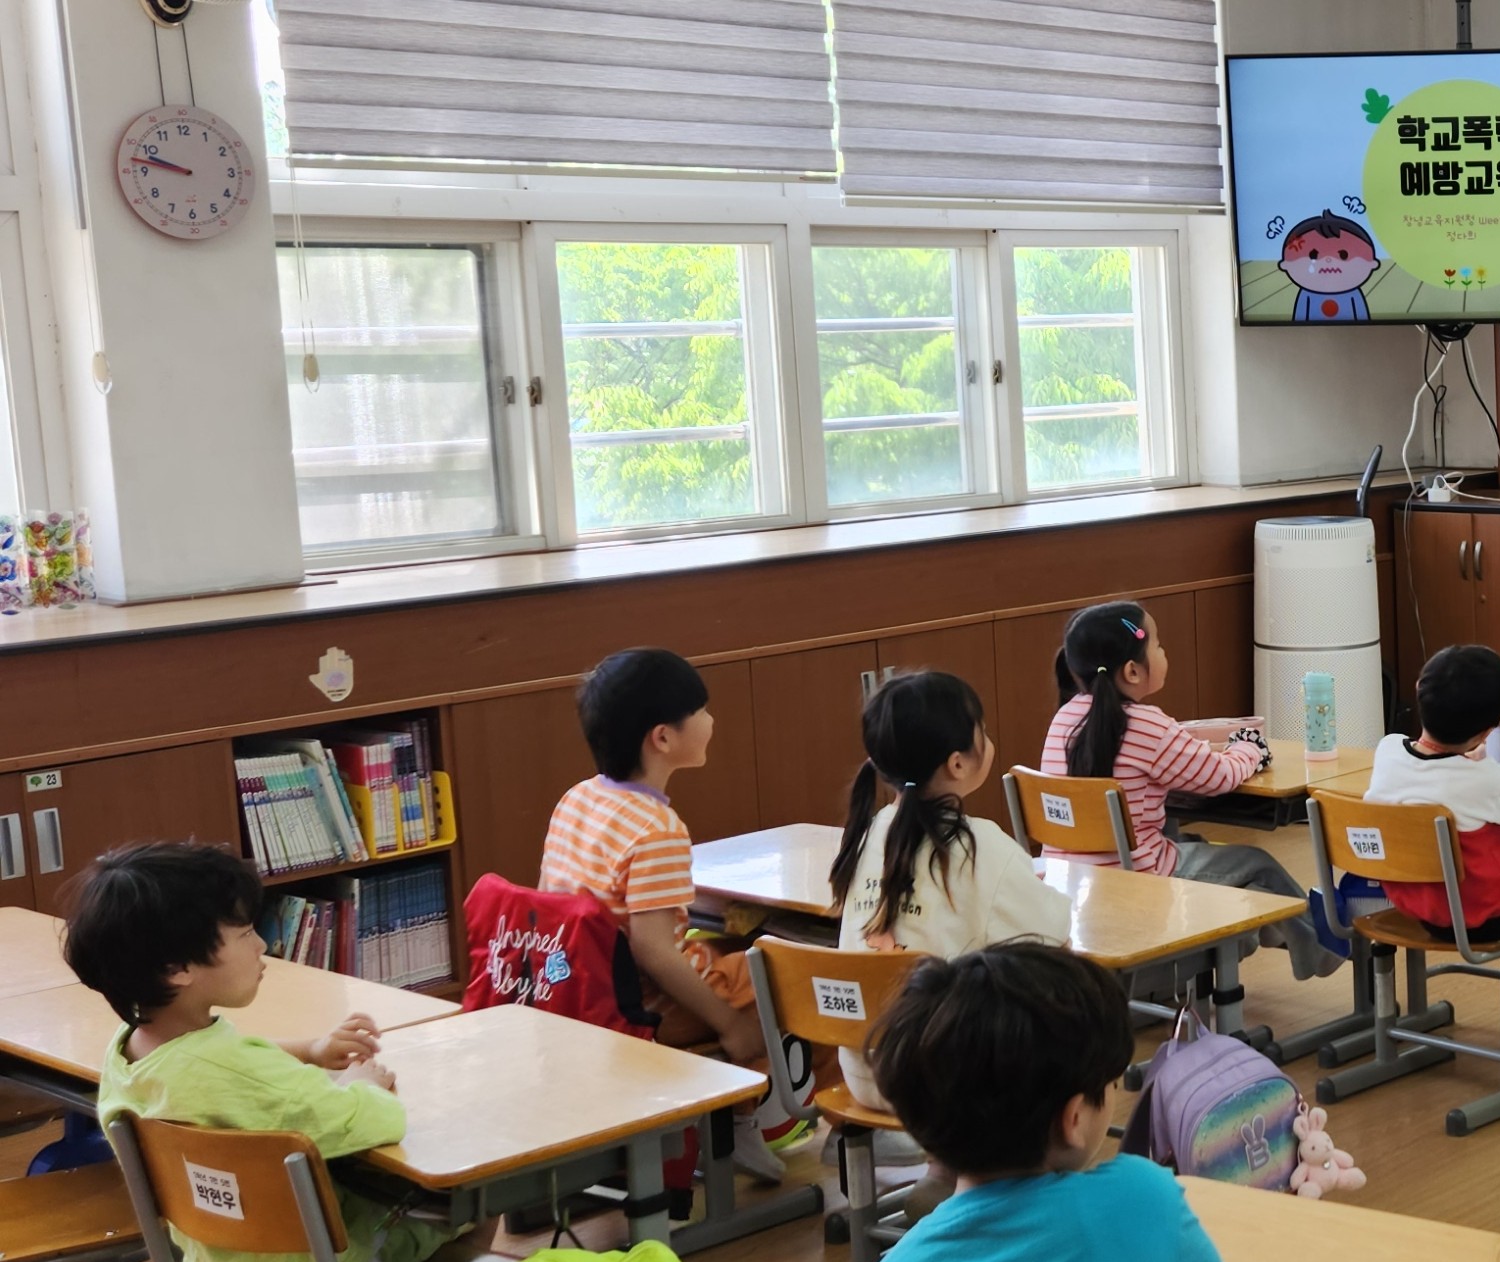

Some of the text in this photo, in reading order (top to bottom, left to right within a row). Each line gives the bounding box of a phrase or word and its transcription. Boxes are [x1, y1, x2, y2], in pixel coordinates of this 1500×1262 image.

[177, 125, 190, 135] 12
[157, 131, 168, 141] 11
[202, 132, 208, 142] 1
[143, 145, 158, 155] 10
[218, 147, 226, 157] 2
[141, 167, 148, 177] 9
[228, 168, 235, 178] 3
[152, 188, 159, 198] 8
[223, 188, 231, 198] 4
[168, 203, 175, 213] 7
[210, 203, 218, 213] 5
[189, 209, 196, 219] 6
[1403, 214, 1474, 226] 창녕교육지원청
[46, 774, 57, 785] 23
[196, 1183, 236, 1210] 박현우
